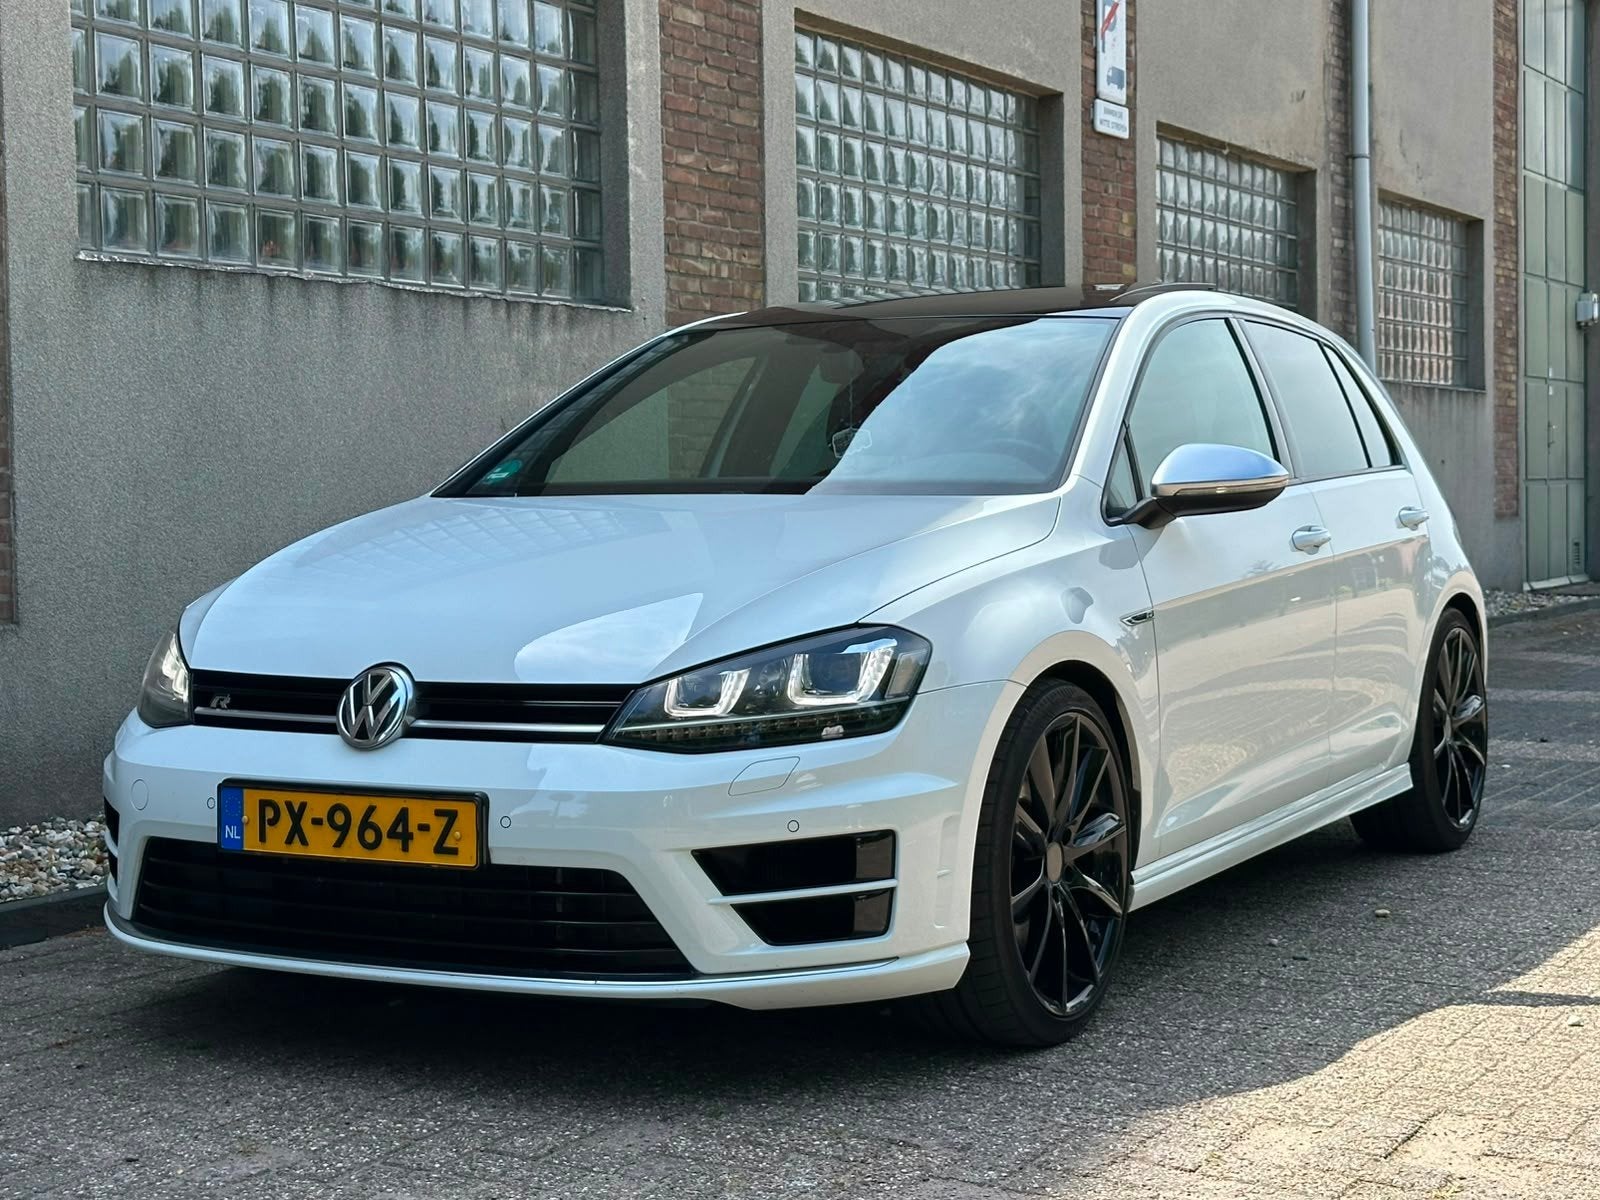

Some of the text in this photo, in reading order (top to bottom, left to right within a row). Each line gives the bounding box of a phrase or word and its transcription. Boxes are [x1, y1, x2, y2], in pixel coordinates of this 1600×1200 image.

[209, 694, 231, 709] R
[224, 825, 241, 840] NL
[258, 798, 459, 856] PX-964-Z
